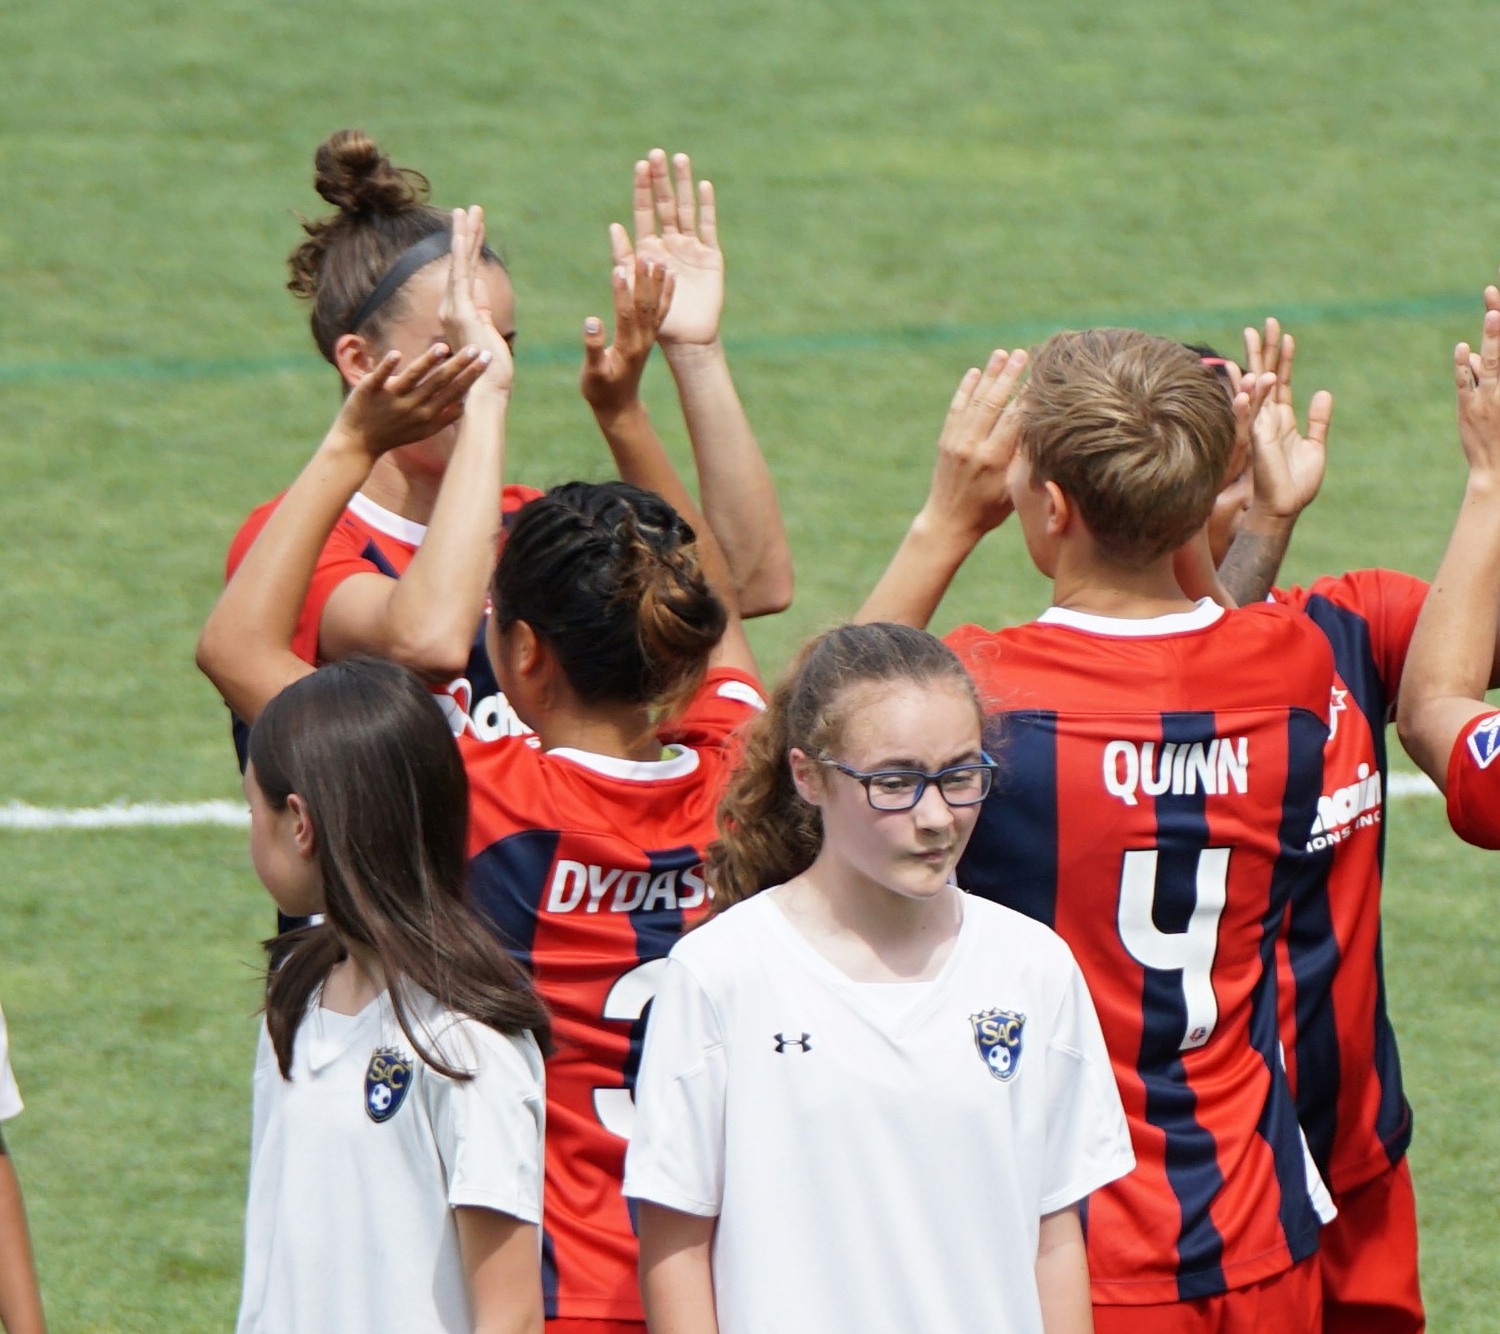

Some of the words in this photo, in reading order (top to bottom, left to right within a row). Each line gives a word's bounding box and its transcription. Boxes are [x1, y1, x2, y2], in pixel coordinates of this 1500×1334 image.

[1103, 737, 1249, 806] QUINN
[546, 858, 716, 914] DYDAS
[1117, 847, 1233, 1052] 4
[981, 1019, 1020, 1047] SAC
